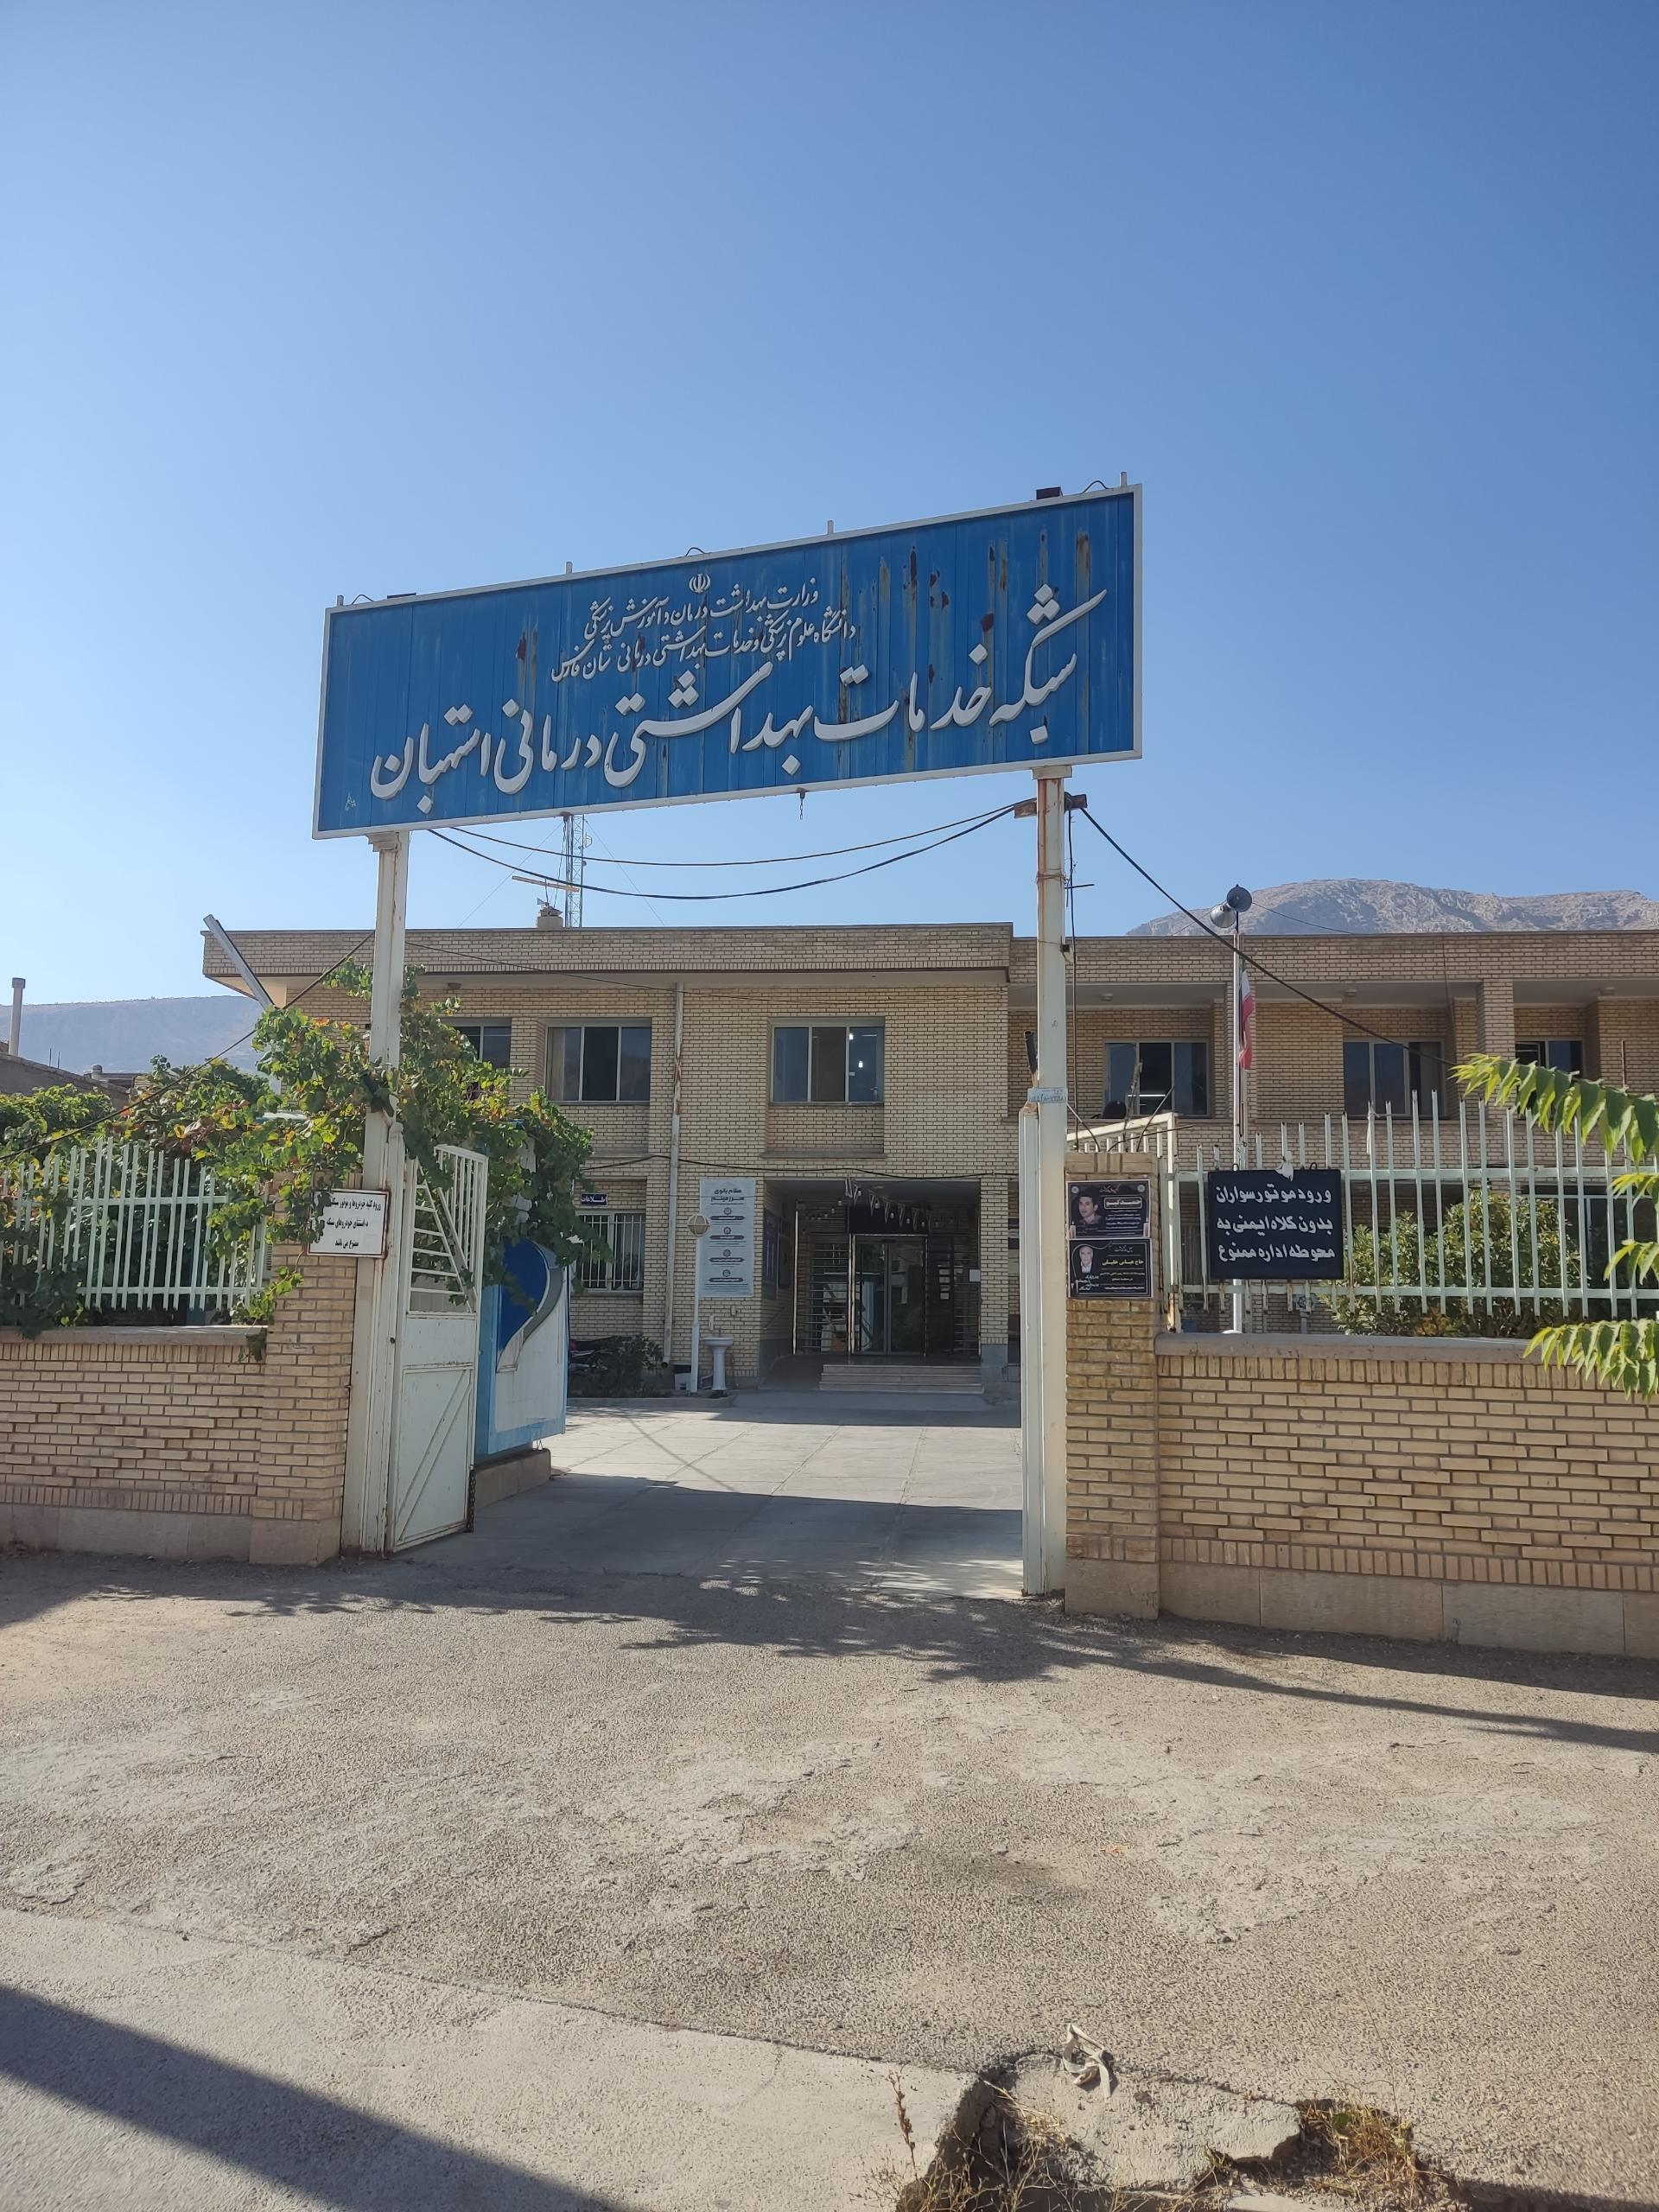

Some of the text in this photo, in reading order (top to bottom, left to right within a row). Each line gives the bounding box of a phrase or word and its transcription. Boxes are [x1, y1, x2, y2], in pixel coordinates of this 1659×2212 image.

[709, 583, 767, 621] بهداشت
[767, 577, 818, 610] وزارت
[584, 596, 614, 644] پزشکی
[610, 596, 670, 637] آموزش
[670, 602, 708, 626] درمان
[813, 606, 856, 643] دانشگاه
[652, 625, 707, 670] بهداشتی
[704, 627, 754, 658] خدمات
[751, 637, 760, 652] و
[760, 609, 792, 662] پزشکی
[788, 617, 816, 662] علوم
[551, 638, 595, 682] فارس
[617, 638, 651, 672] درمانی
[370, 583, 1107, 814] شبکه خدمات بهداشتی درمانی استهبان
[1297, 1188, 1332, 1204] ورود
[1217, 1214, 1333, 1236] بدون کلاه ایمنی به
[1218, 1241, 1335, 1262] محوطه اداره ممنوع
